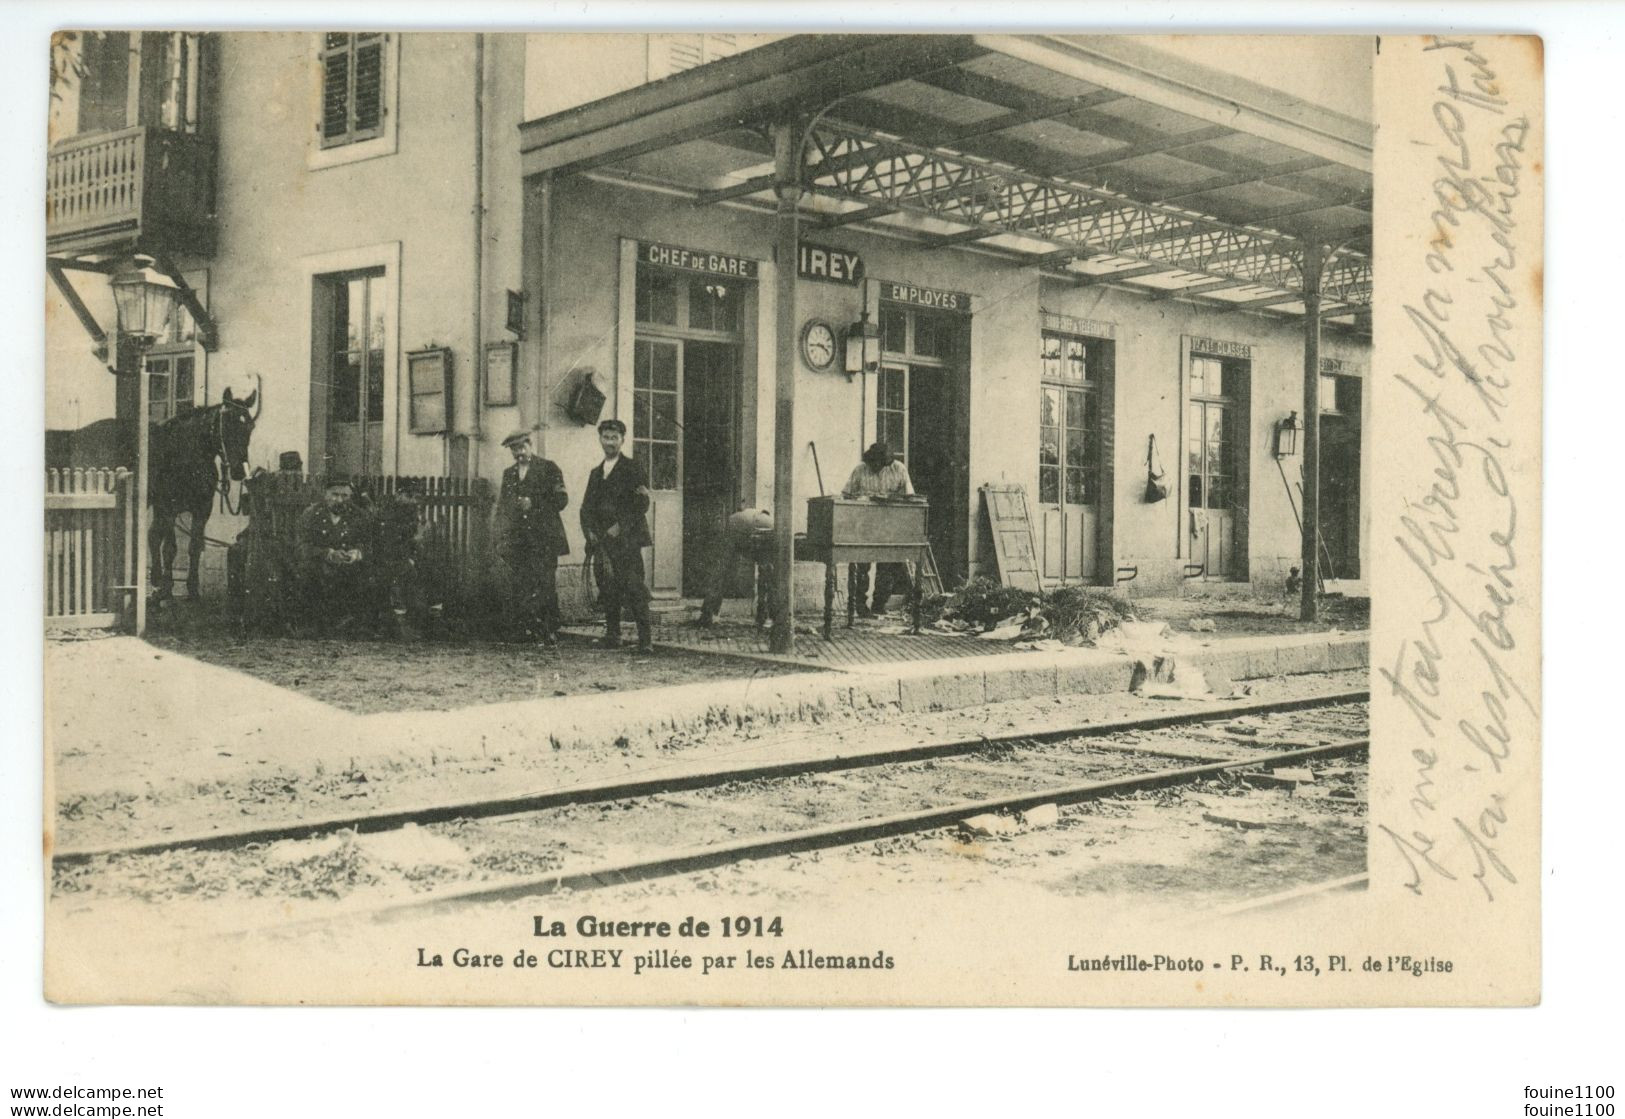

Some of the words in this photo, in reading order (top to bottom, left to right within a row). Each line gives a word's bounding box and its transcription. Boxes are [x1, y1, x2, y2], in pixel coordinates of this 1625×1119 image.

[649, 245, 690, 267] CHEF
[692, 255, 706, 270] DE
[708, 255, 748, 276] GARE
[801, 247, 859, 281] IREY
[892, 285, 957, 309] EMPLOYES
[534, 916, 566, 937] La
[577, 916, 670, 937] Guerre
[679, 917, 709, 937] de
[721, 917, 783, 937] 1914
[417, 948, 443, 967] La
[453, 949, 503, 968] Gare
[514, 950, 537, 968] de
[548, 950, 622, 968] CIREY
[634, 950, 691, 974] pillée
[703, 957, 736, 974] par
[747, 950, 774, 969] les
[782, 950, 894, 969] Allemands
[1068, 955, 1203, 972] Lunéville-Photo
[1231, 955, 1249, 972] P.
[1260, 955, 1287, 976] R.,
[1294, 956, 1320, 976] 13,
[1329, 956, 1352, 972] Pl.
[1363, 956, 1382, 972] de
